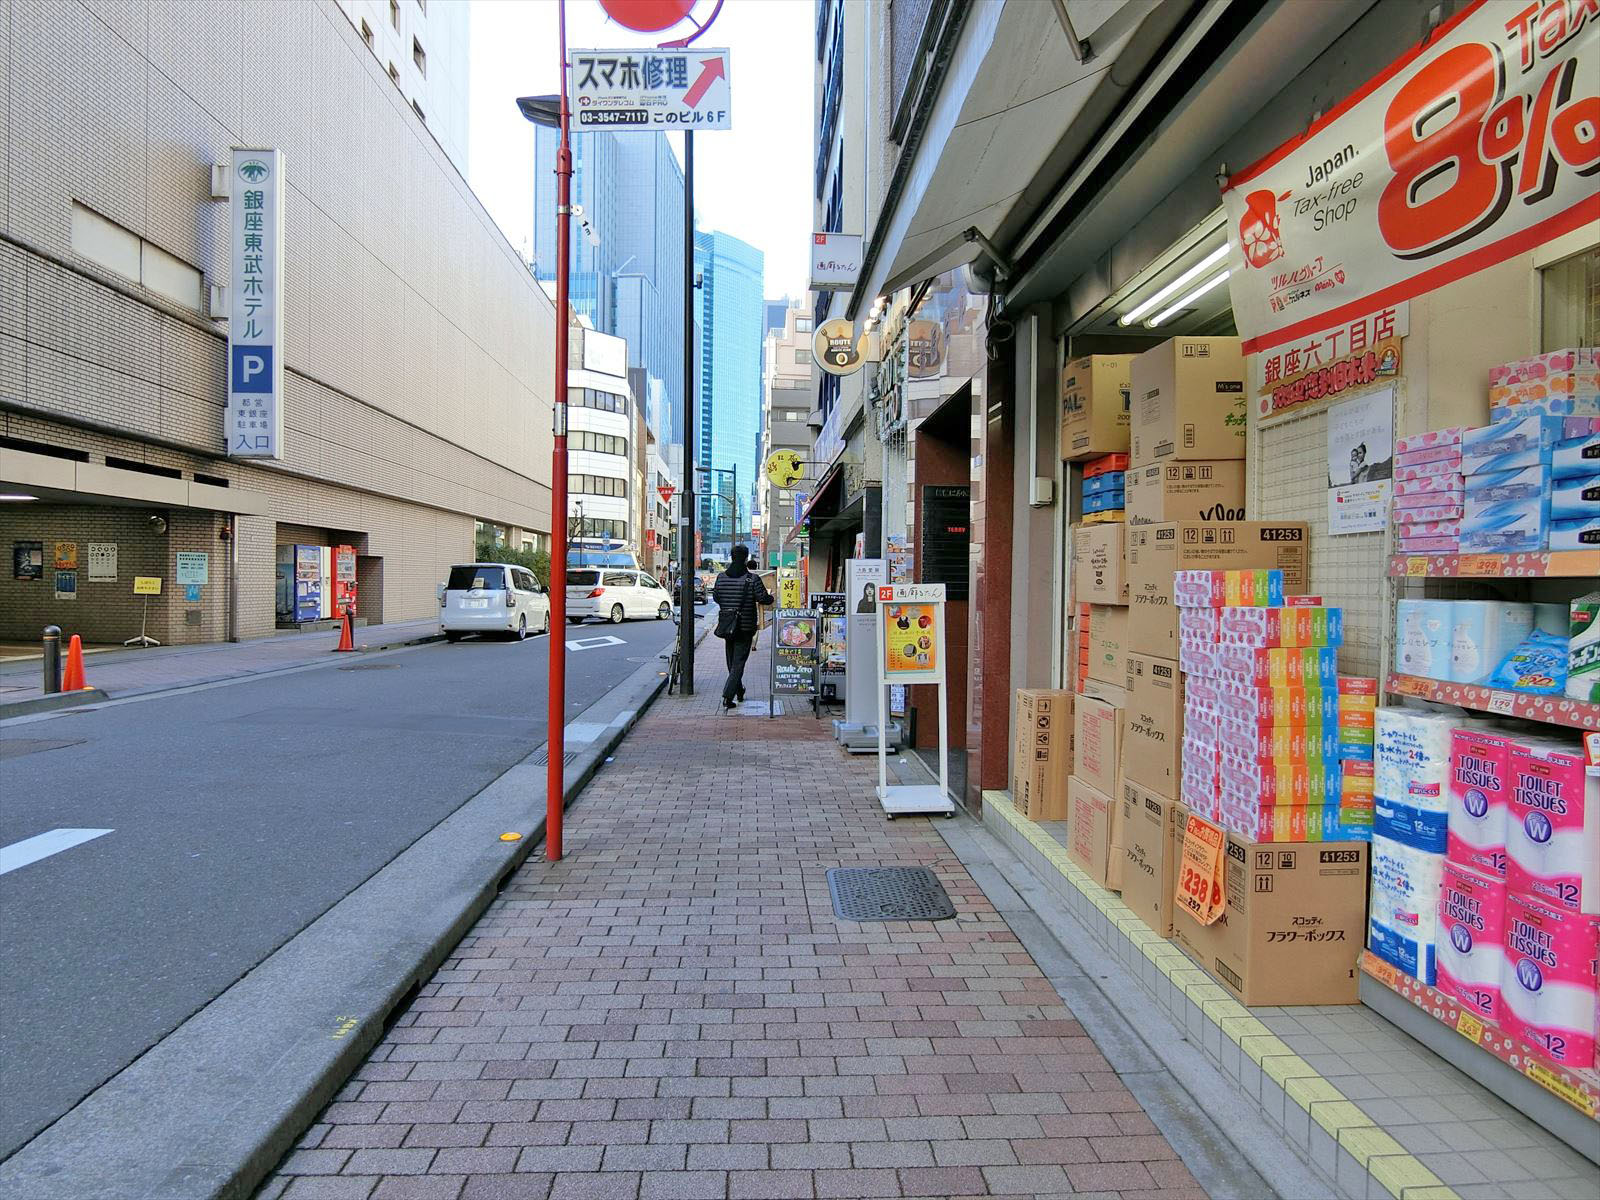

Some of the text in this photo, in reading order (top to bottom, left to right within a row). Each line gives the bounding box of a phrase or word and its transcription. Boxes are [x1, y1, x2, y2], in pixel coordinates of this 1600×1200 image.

[578, 56, 688, 90] スマホ修理
[582, 112, 648, 122] 03-3547-7117
[1305, 144, 1360, 188] Japan.
[1293, 170, 1364, 219] Tax-free
[1313, 198, 1357, 232] Shop
[815, 235, 825, 243] 2F
[243, 190, 265, 339] 銀座東武ホテル
[1264, 309, 1396, 385] 銀座六丁目店
[243, 355, 265, 383] P
[238, 410, 268, 418] 東銀座
[237, 421, 268, 429] 駐車場
[236, 434, 269, 449] 入口
[1168, 469, 1178, 477] 12
[1186, 530, 1196, 539] 12
[1263, 530, 1300, 540] 41253
[881, 589, 892, 599] 2F
[1135, 594, 1168, 606] フラワーボックス
[1153, 665, 1171, 678] 41253
[1494, 700, 1510, 708] 179
[1130, 722, 1165, 742] フラワーボックス
[1459, 755, 1496, 775] TOILET
[1456, 768, 1501, 790] TISSUES
[1518, 773, 1563, 797] TOILET
[1468, 797, 1484, 815] W
[1514, 788, 1566, 815] TISSUES
[1529, 819, 1547, 841] W
[1228, 842, 1245, 863] 253
[1258, 854, 1271, 865] 12
[1322, 852, 1357, 862] 41253
[1491, 853, 1505, 870] 12
[1184, 868, 1208, 903] 238
[1556, 882, 1578, 903] 12
[1188, 897, 1201, 912] 257
[1448, 889, 1482, 915] TOILET
[1292, 916, 1321, 926] スコッティ
[1443, 901, 1484, 932] TISSUES
[1266, 930, 1346, 942] フラワーボックス
[1454, 934, 1471, 951] W
[1512, 918, 1553, 949] TOILET
[1507, 931, 1557, 968] TISSUES
[1349, 970, 1354, 978] 1
[1523, 968, 1540, 988] W
[1474, 991, 1492, 1011] 12
[1544, 1034, 1566, 1056] 12
